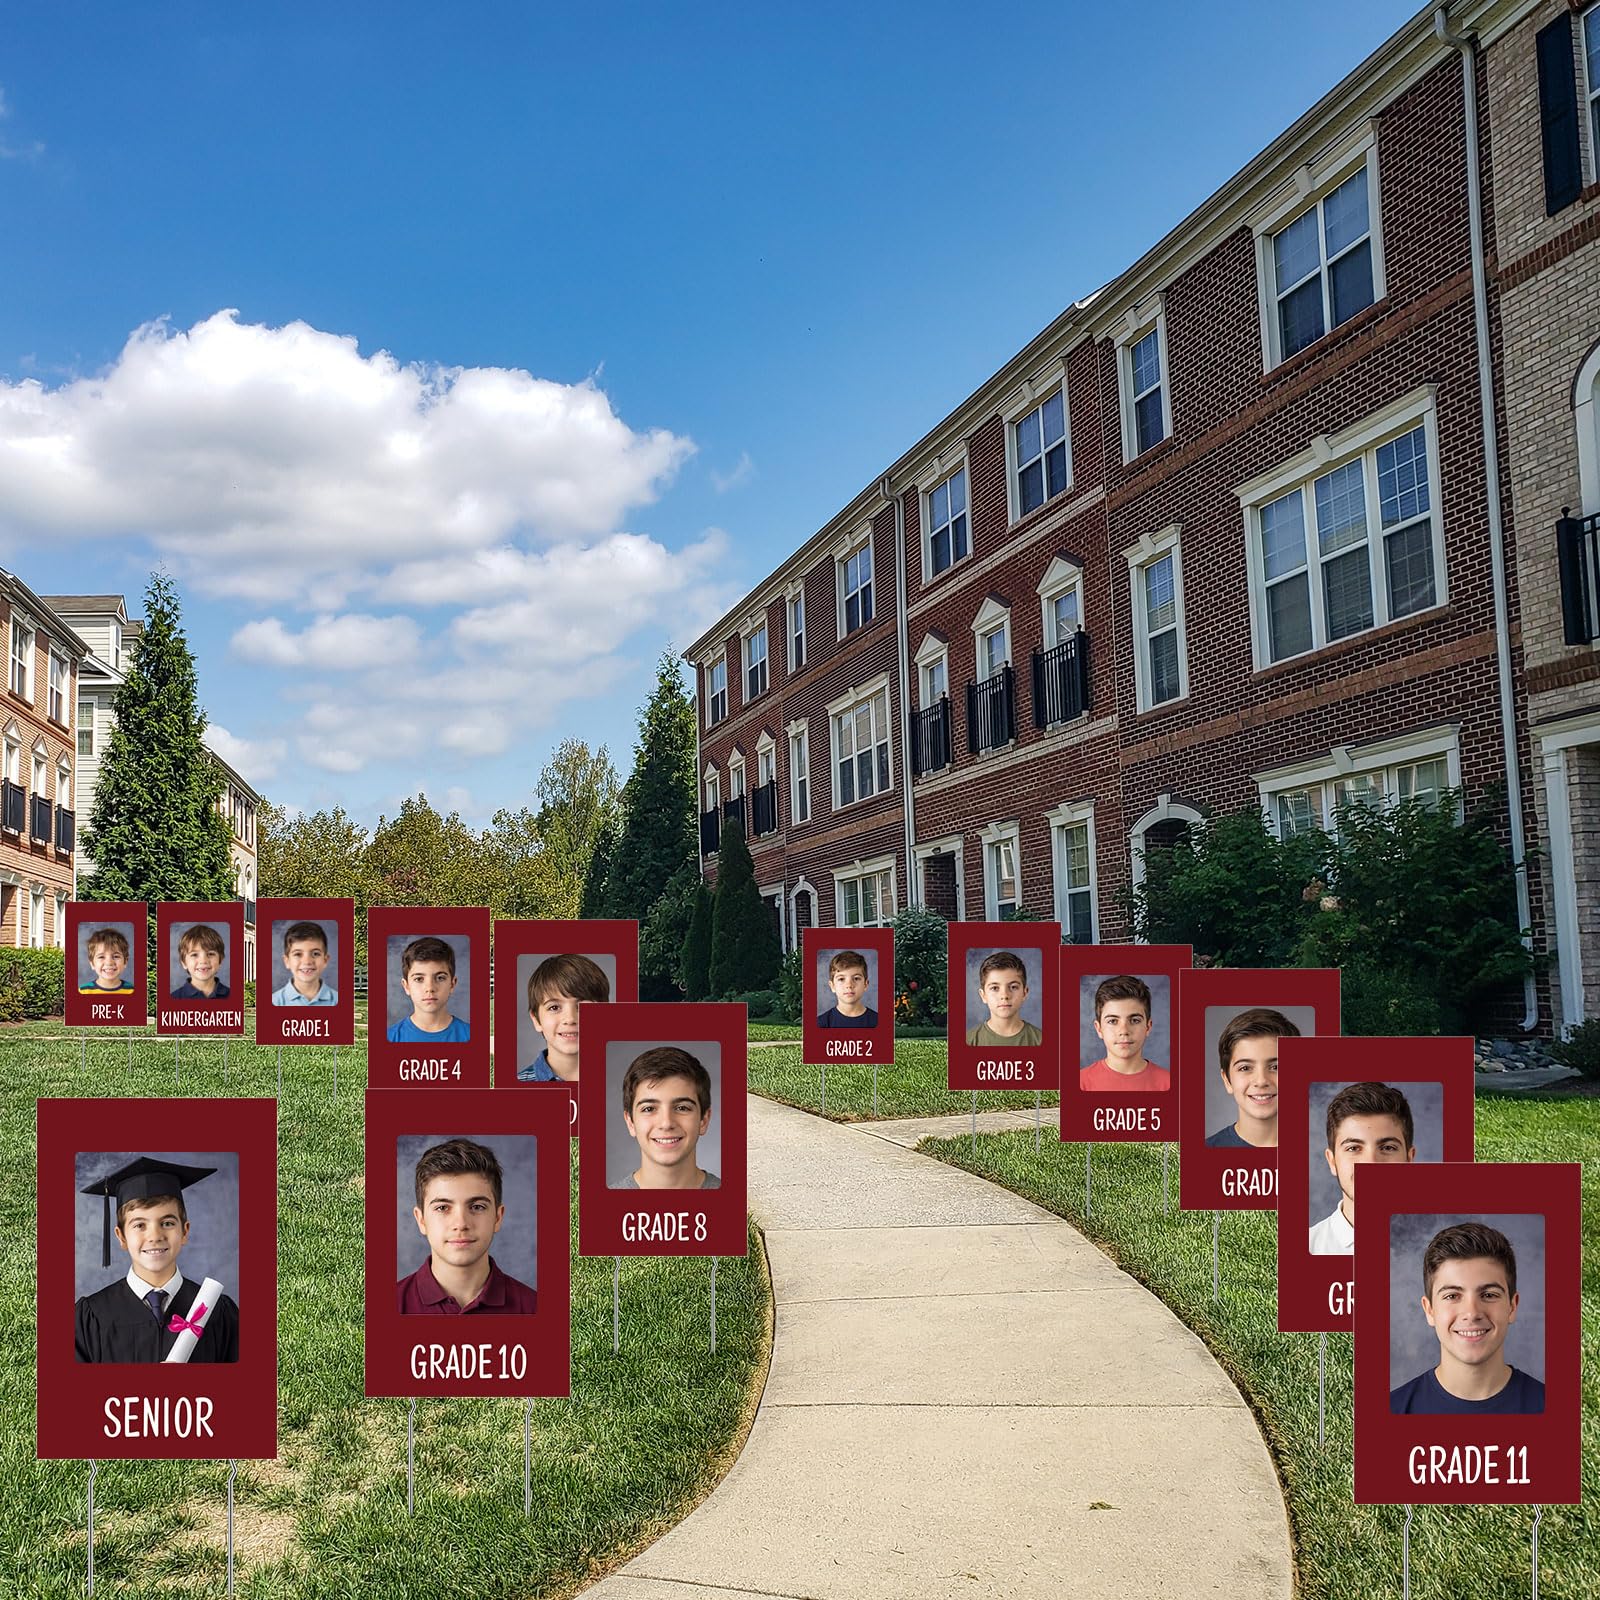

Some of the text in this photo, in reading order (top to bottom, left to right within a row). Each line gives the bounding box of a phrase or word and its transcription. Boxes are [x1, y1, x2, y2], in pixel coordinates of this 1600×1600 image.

[92, 1004, 125, 1019] PRE-K
[161, 1010, 242, 1027] KINDERGARTEN
[281, 1019, 330, 1037] GRADE 1
[825, 1040, 873, 1057] GRADE 2
[399, 1059, 462, 1081] GRADE 4
[976, 1060, 1035, 1081] GRADE 3
[1093, 1107, 1161, 1132] GRADE 5
[1221, 1168, 1278, 1197] GRAD
[622, 1212, 708, 1242] GRADE 8
[410, 1343, 527, 1380] GRADE 10
[103, 1396, 214, 1439] SENIOR
[1408, 1445, 1531, 1485] GRADE 11
